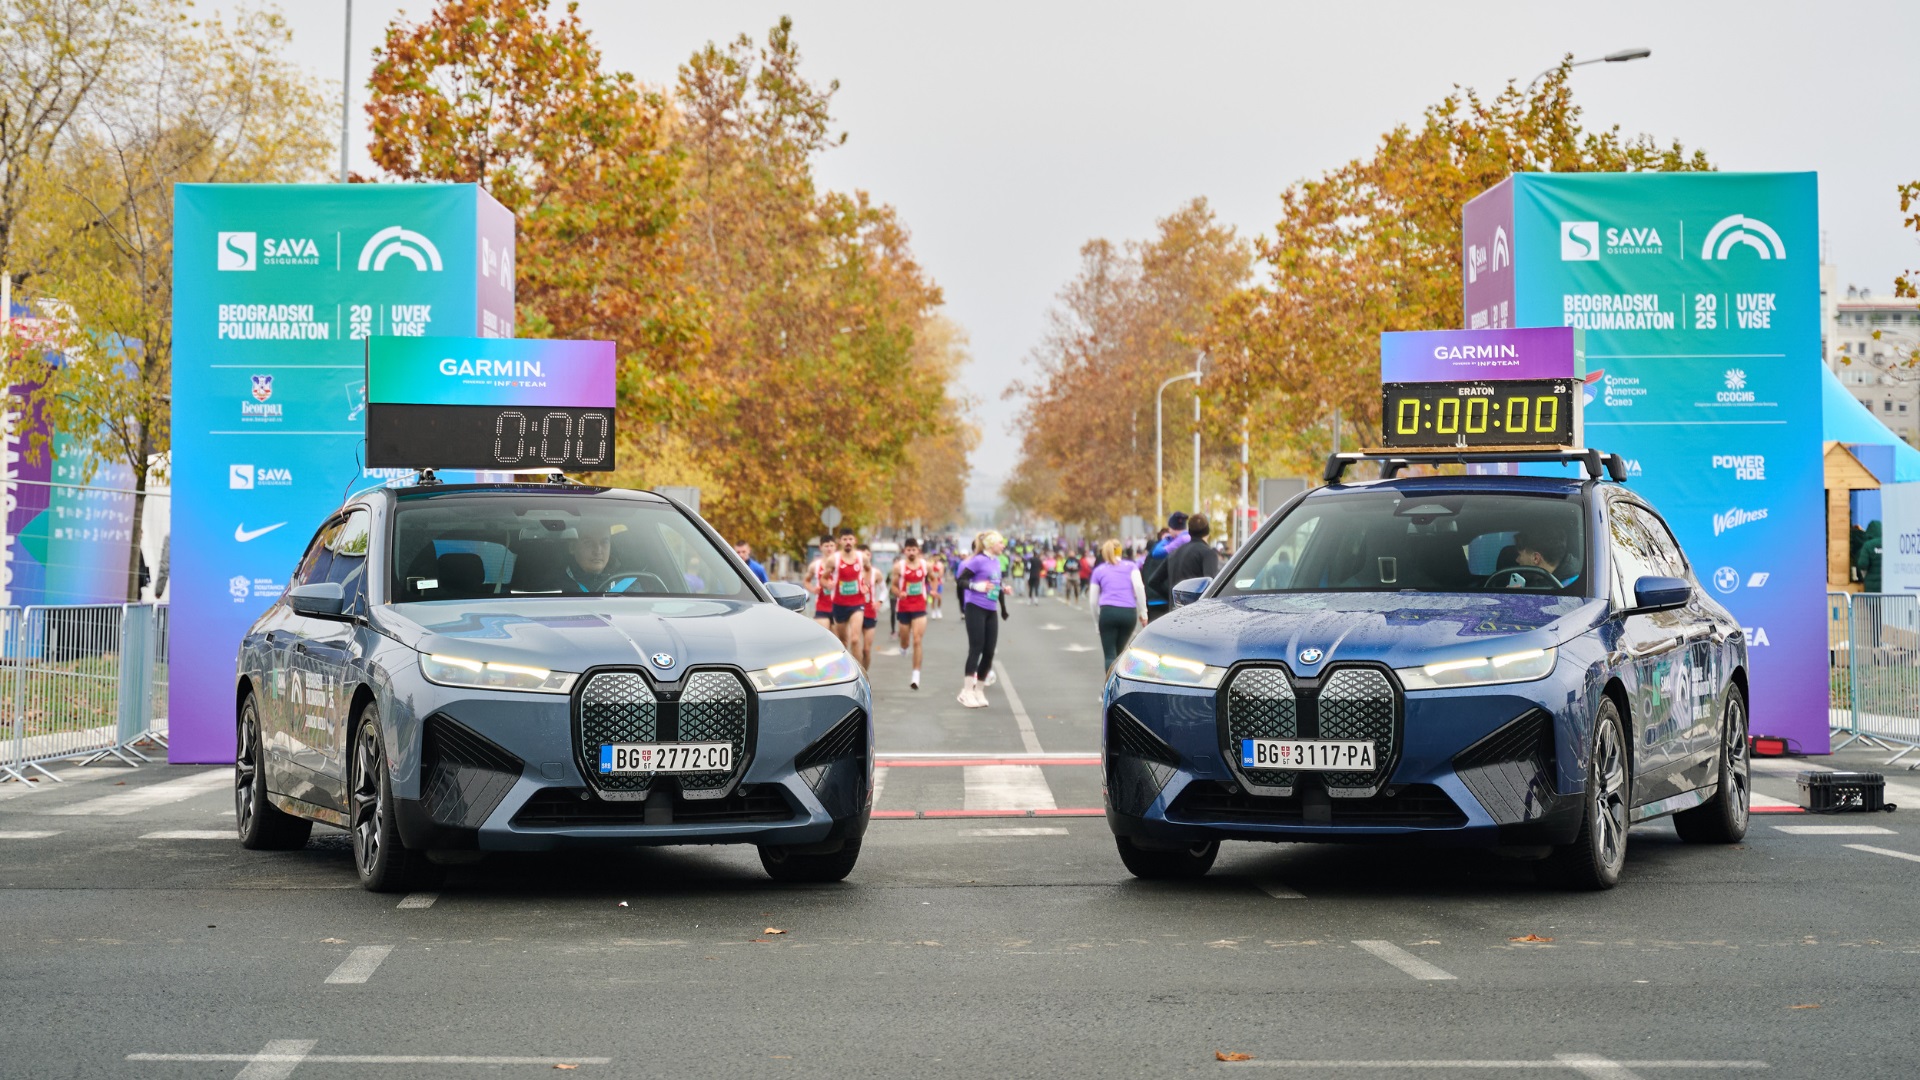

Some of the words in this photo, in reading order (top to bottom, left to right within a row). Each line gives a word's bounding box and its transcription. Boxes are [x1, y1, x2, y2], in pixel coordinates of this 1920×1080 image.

[1606, 228, 1663, 246] SAVA
[263, 238, 319, 257] SAVA
[1563, 294, 1659, 312] BEOGRADSKI
[1695, 294, 1717, 311] 20
[1736, 293, 1776, 311] UVEK
[218, 304, 314, 322] BEOGRADSKI
[350, 305, 372, 322] 20
[391, 305, 432, 322] UVEK
[1563, 312, 1675, 330] POLUMARATON
[1695, 311, 1717, 330] 25
[1737, 309, 1771, 329] VIŠE
[218, 322, 329, 340] POLUMARATON
[350, 322, 372, 340] 25
[392, 320, 425, 337] VIŠE
[1604, 375, 1640, 387] Српски
[1458, 387, 1495, 396] ERATON
[1554, 385, 1566, 394] 29
[1605, 385, 1648, 396] Атлетски
[1716, 391, 1755, 402] ССОСИБ
[241, 400, 283, 417] Београд
[1604, 395, 1633, 407] Савез
[1397, 396, 1559, 434] 0:00:00
[494, 411, 607, 464] 0:00
[1622, 459, 1642, 471] VA
[1712, 455, 1765, 469] POWER
[258, 469, 292, 480] SAVA
[1713, 507, 1768, 537] Wellness
[616, 748, 640, 769] BG
[1257, 743, 1278, 764] BG
